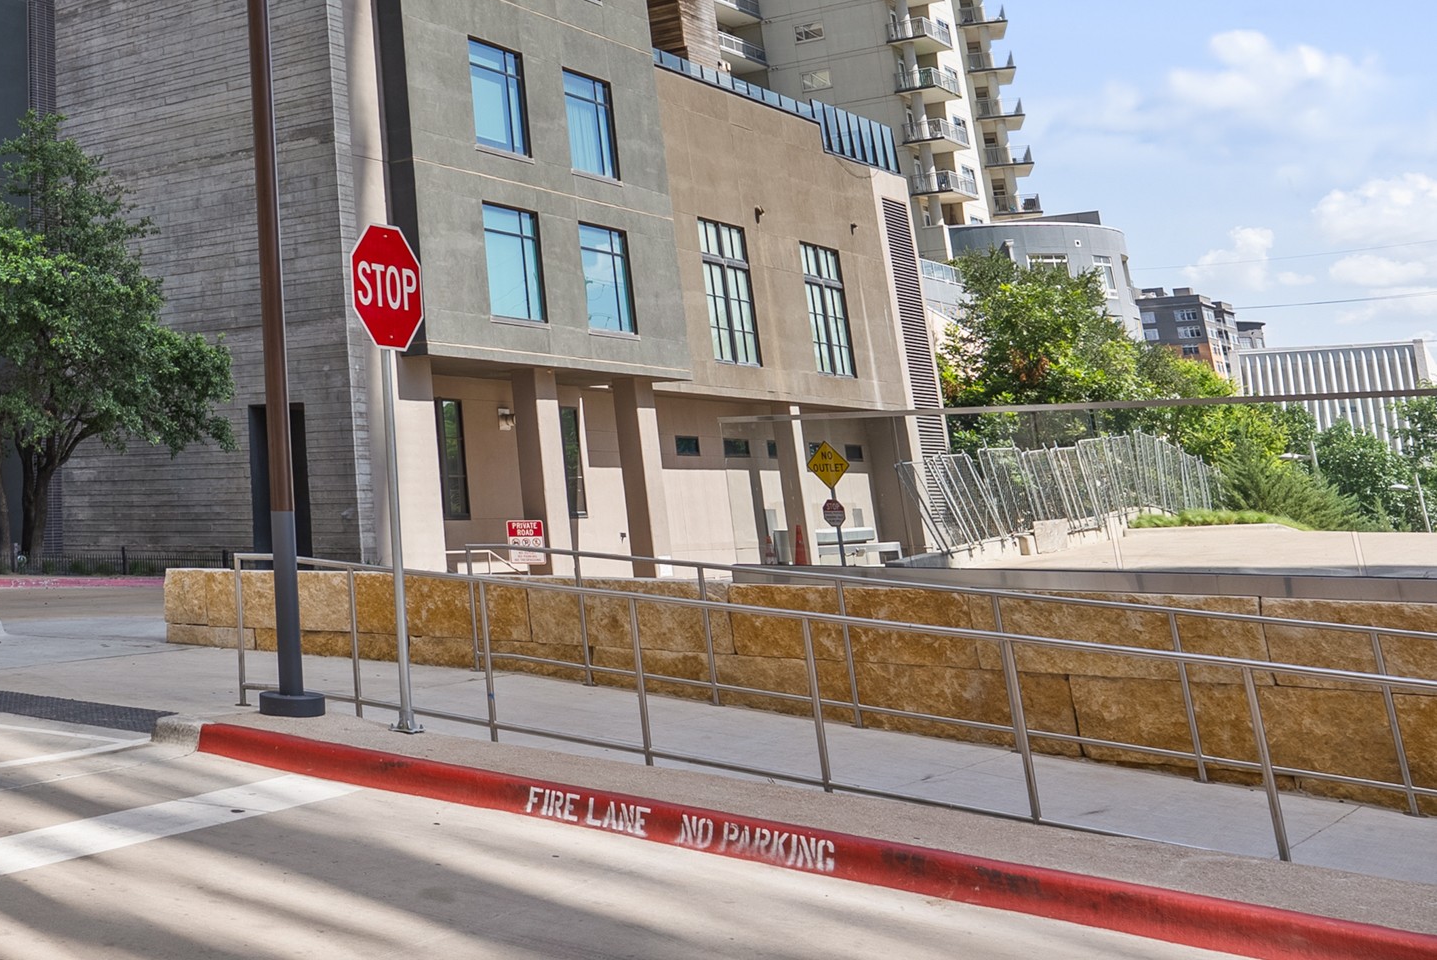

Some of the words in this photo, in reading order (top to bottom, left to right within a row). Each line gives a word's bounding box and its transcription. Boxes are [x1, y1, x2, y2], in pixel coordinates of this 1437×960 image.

[357, 260, 417, 311] STOP
[821, 451, 833, 460] NO
[813, 463, 844, 472] OUTLET
[826, 502, 841, 510] STOP
[526, 786, 580, 822] FIRE
[585, 797, 651, 837] LANE
[675, 814, 714, 849] NO
[718, 821, 835, 872] PARKING
